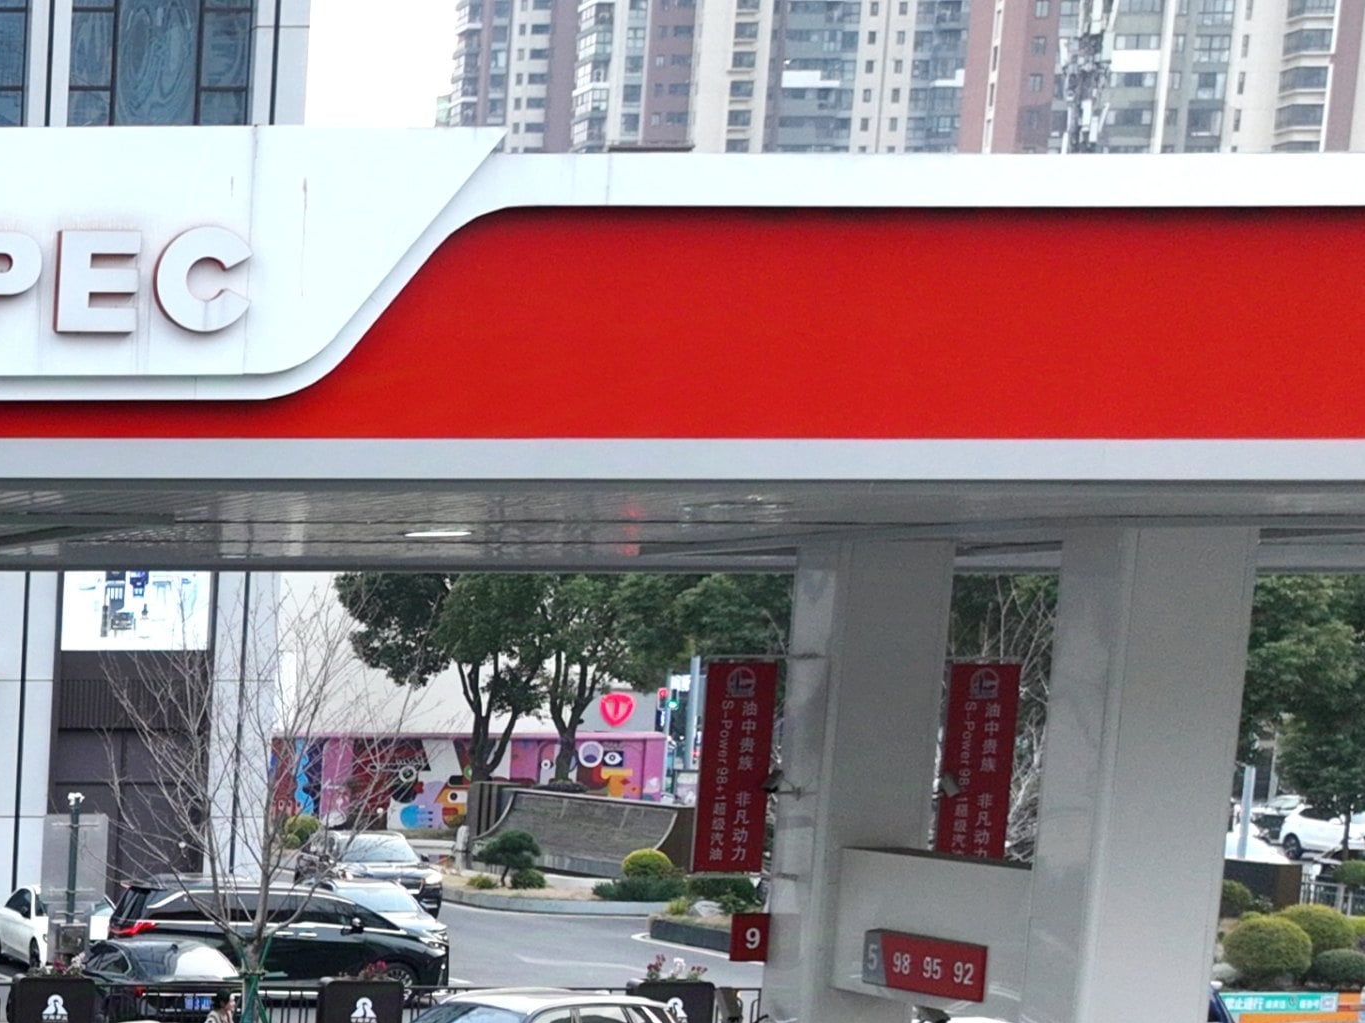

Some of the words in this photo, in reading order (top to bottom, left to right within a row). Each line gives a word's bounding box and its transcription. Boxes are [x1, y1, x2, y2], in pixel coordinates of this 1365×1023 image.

[737, 701, 758, 770] 油中贵族
[980, 703, 1001, 773] 油中贵族
[731, 791, 752, 861] 非凡动力
[745, 927, 761, 949] 9
[867, 943, 877, 970] 5
[893, 952, 910, 975] 98
[923, 956, 942, 980] 95
[953, 962, 974, 985] 92
